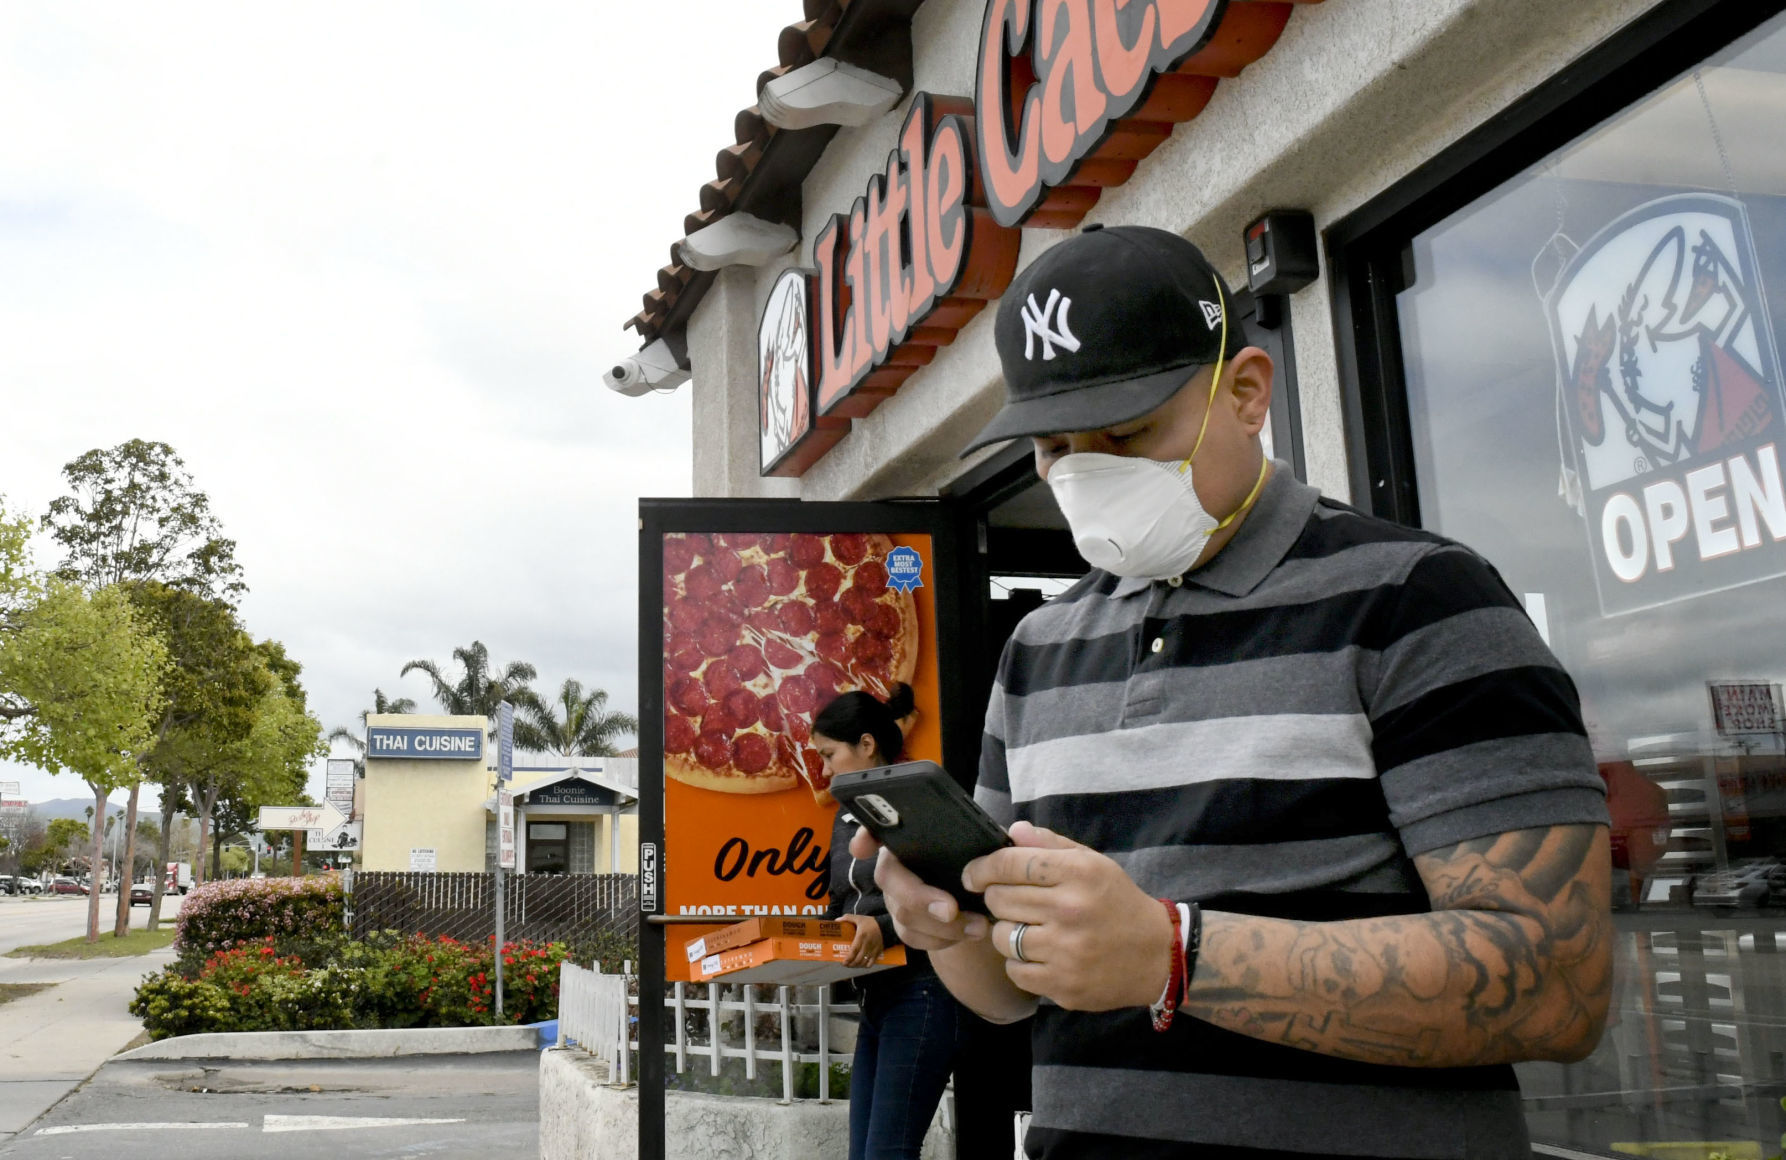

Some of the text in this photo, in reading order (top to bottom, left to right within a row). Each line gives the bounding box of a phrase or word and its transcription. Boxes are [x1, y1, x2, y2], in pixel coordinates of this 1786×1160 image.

[815, 0, 1211, 408] Little Cae
[1021, 288, 1081, 361] NY
[1601, 441, 1786, 583] OPEN
[373, 734, 475, 752] THAI CUISINE
[539, 794, 600, 804] Thai Cuisine
[553, 785, 586, 794] Boonie
[643, 848, 654, 895] PUSH
[714, 826, 832, 900] Only
[799, 942, 822, 951] DOUGH
